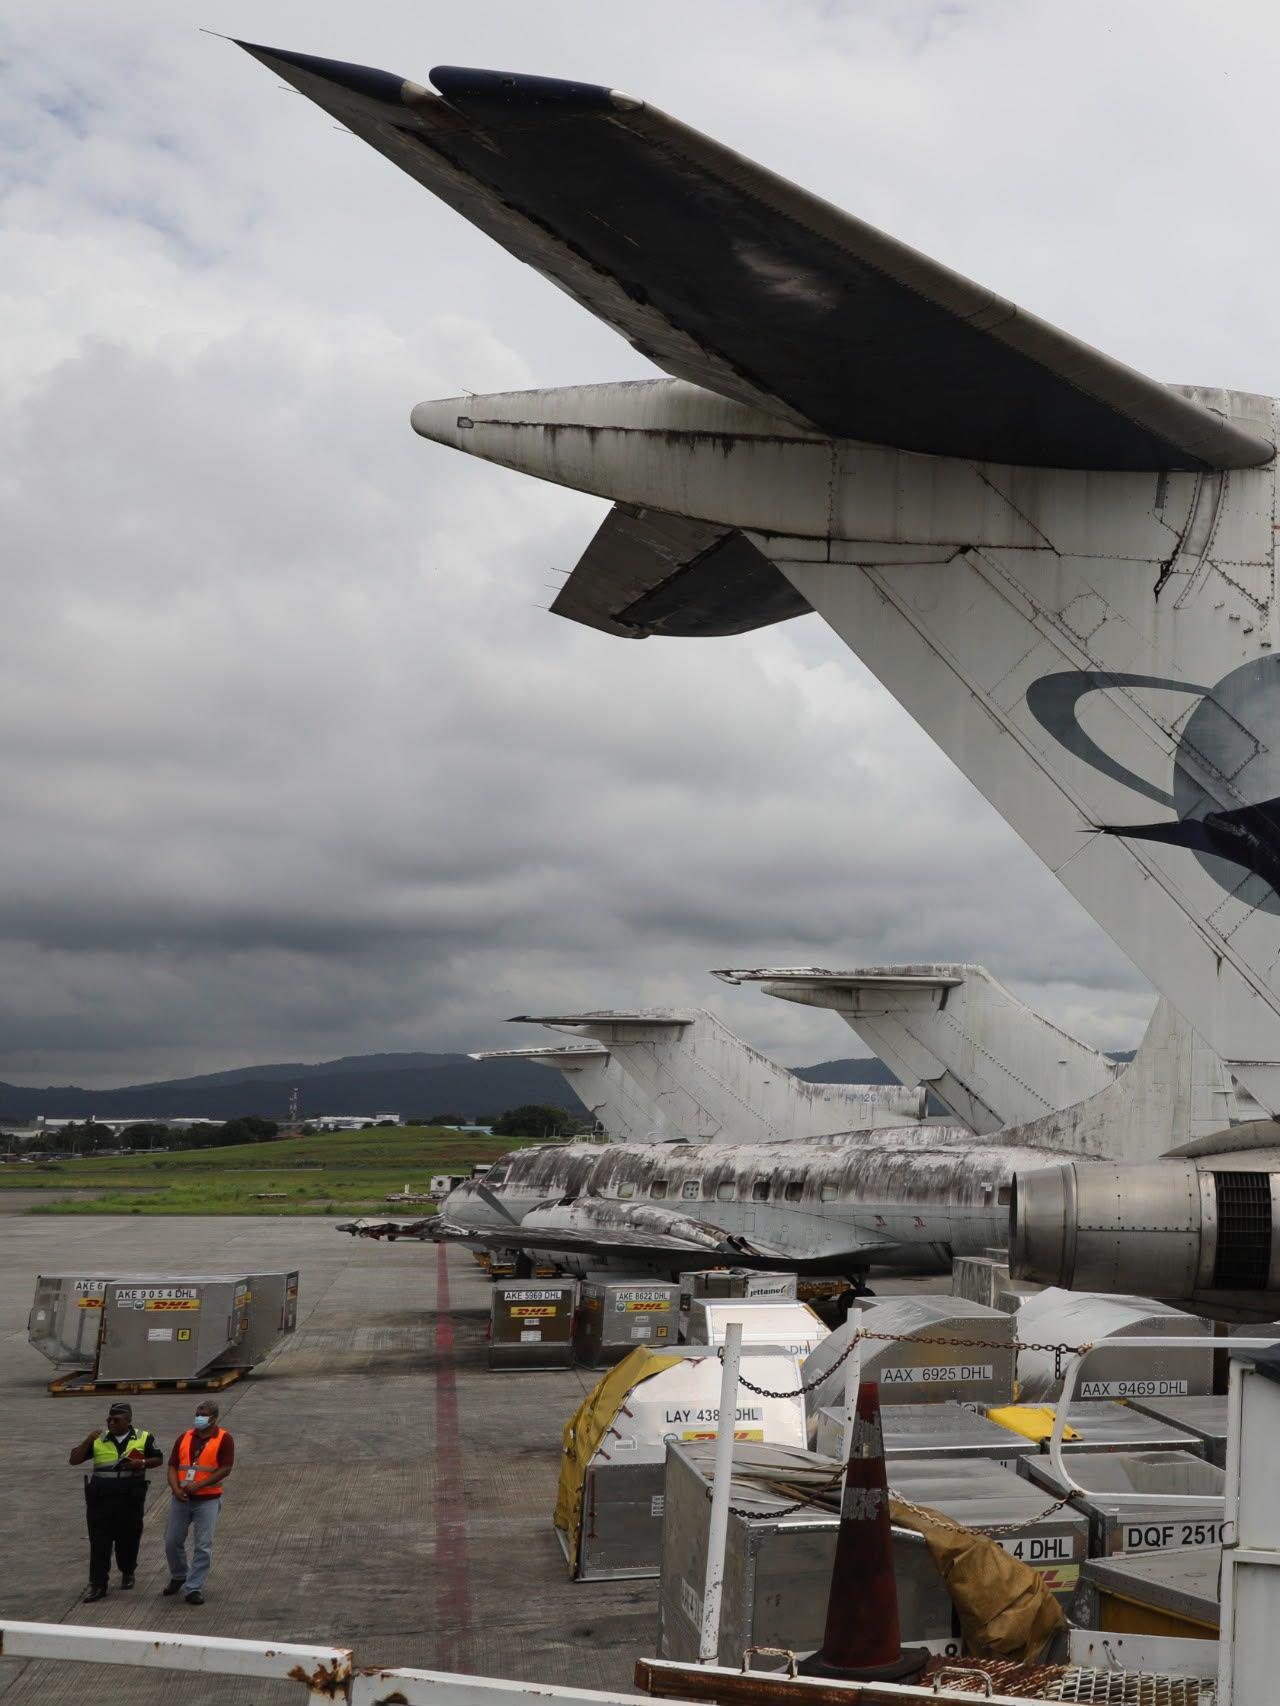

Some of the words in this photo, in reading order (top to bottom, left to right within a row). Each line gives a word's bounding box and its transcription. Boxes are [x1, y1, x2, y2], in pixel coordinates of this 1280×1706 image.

[75, 1282, 95, 1291] AKE
[117, 1290, 137, 1299] AKE
[175, 1290, 195, 1299] DHL
[505, 1292, 522, 1300] AKE
[524, 1291, 543, 1299] 5969
[544, 1291, 561, 1299] DHL
[618, 1292, 634, 1300] AKE
[635, 1292, 653, 1300] 8622
[654, 1291, 668, 1300] DHL
[153, 1301, 192, 1310] DHL
[516, 1308, 552, 1316] DHL
[883, 1368, 914, 1382] AAX
[922, 1367, 956, 1381] 6925
[961, 1366, 991, 1380] DHL
[1082, 1382, 1111, 1396] AAX
[1118, 1382, 1156, 1395] 9469
[1159, 1381, 1186, 1395] DHL
[666, 1409, 691, 1423] LAY
[696, 1408, 720, 1422] 438
[734, 1408, 759, 1421] DHL
[1127, 1526, 1174, 1548] DQF
[1030, 1538, 1070, 1559] DHL
